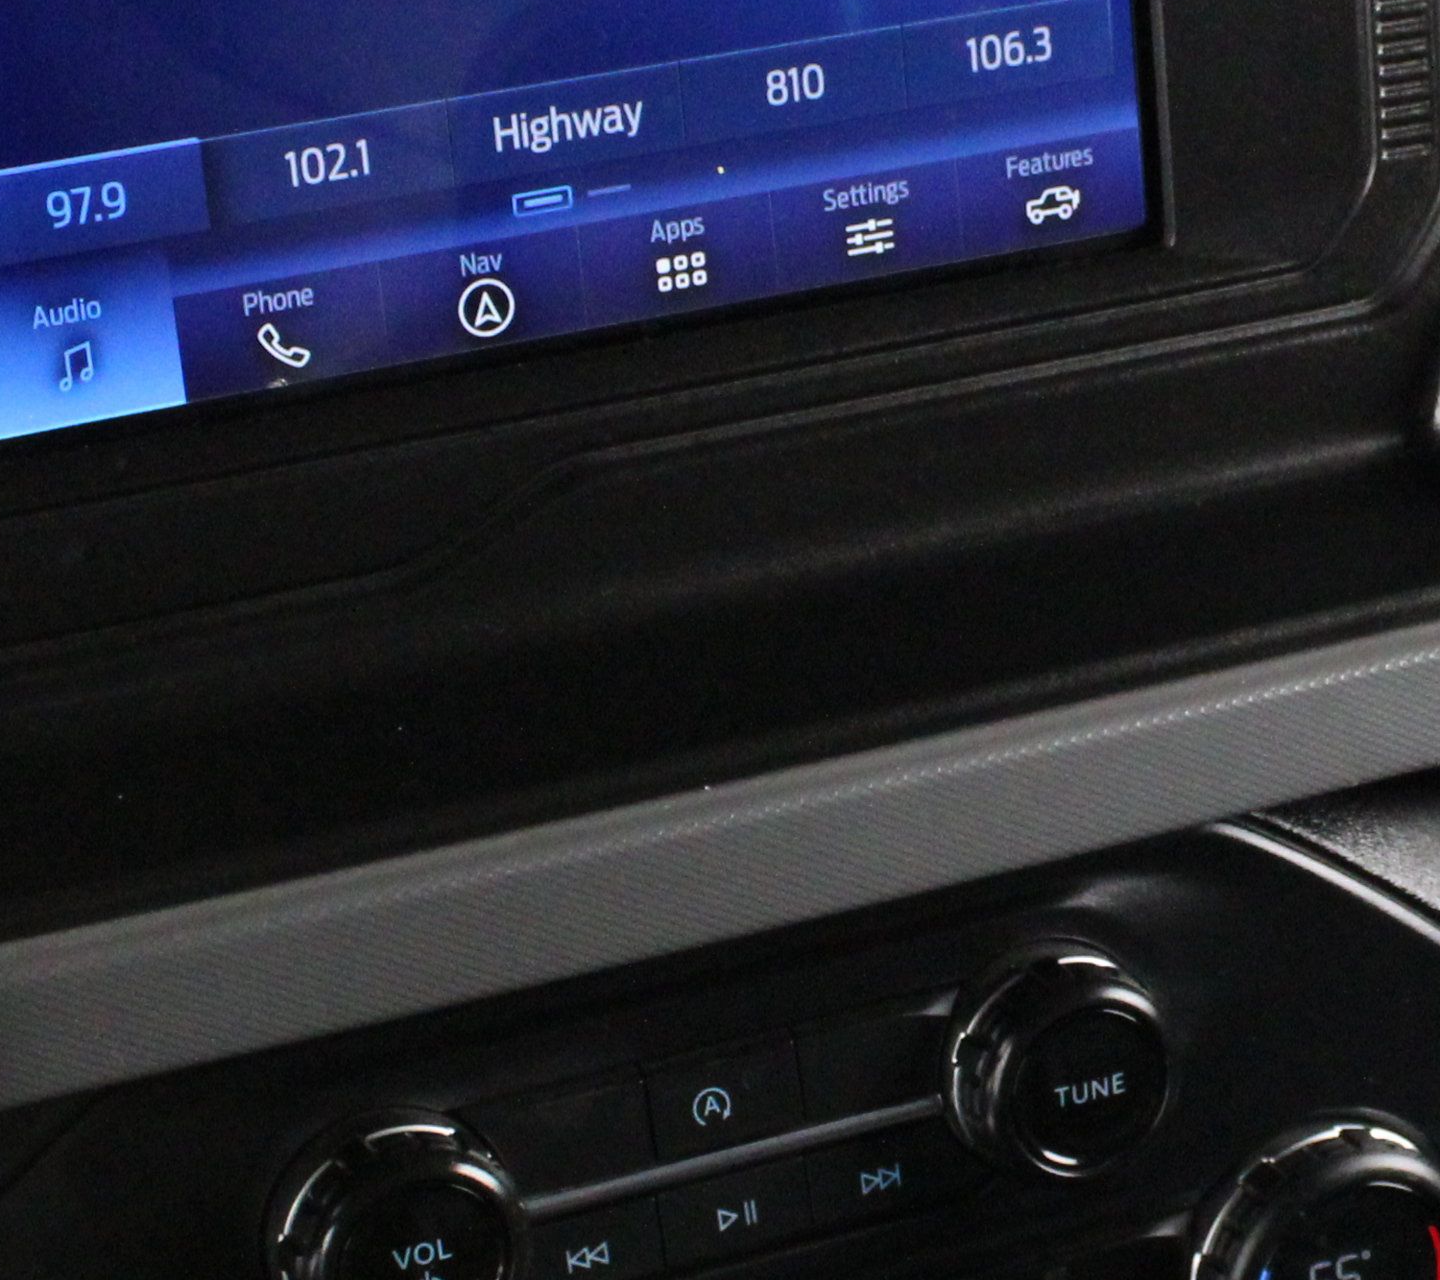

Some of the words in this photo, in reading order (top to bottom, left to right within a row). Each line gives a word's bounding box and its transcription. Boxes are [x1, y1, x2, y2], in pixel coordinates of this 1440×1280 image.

[966, 27, 1051, 72] 106.3
[767, 65, 824, 106] 810
[493, 101, 642, 153] Highway
[285, 139, 370, 187] 102.1
[1006, 146, 1093, 179] Features
[46, 182, 126, 228] 97.9
[823, 178, 909, 211] Settings
[651, 214, 705, 244] Apps
[460, 253, 503, 277] Nav
[33, 298, 101, 329] Audio
[243, 286, 314, 316] Phone
[1054, 1072, 1125, 1106] TUNE
[392, 1239, 452, 1269] VOL
